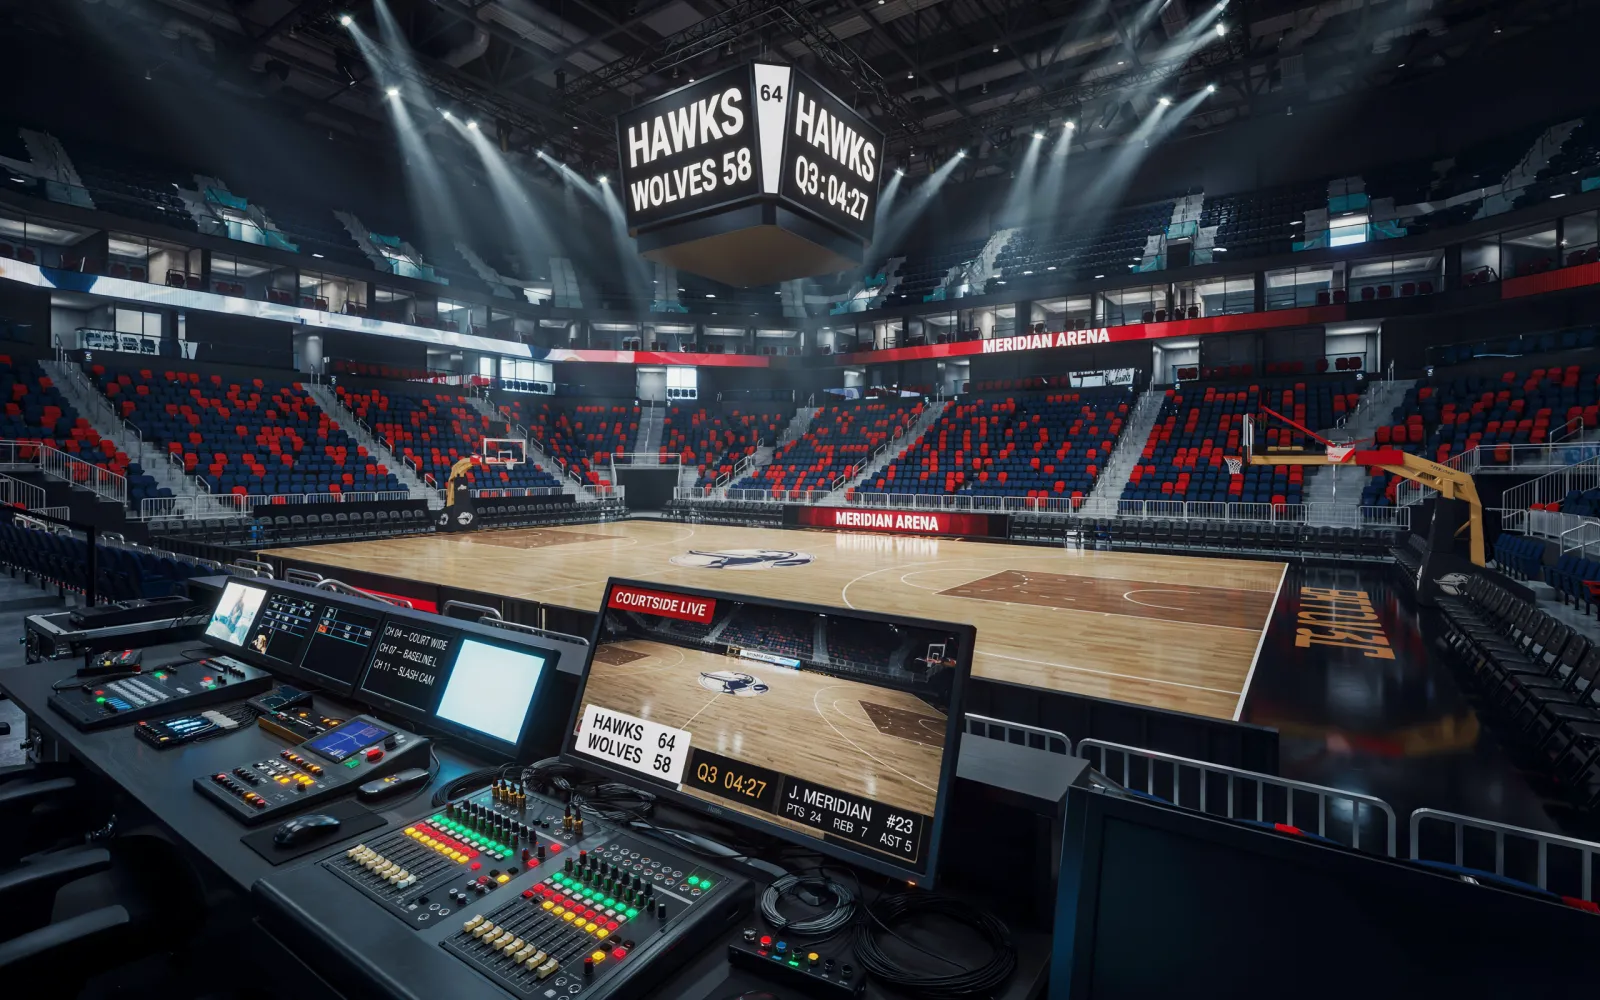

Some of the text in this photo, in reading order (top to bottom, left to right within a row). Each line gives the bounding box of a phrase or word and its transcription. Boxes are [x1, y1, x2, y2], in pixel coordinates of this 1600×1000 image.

[760, 84, 783, 102] 64
[628, 88, 744, 168] HAWKS
[795, 91, 876, 183] HAWKS
[630, 147, 752, 212] WOLVES 58
[982, 328, 1110, 354] MERIDIAN ARENA
[836, 512, 939, 531] MERIDIAN ARENA
[615, 591, 707, 617] COURTSIDE LIVE
[379, 643, 388, 653] CH
[388, 645, 397, 655] 07
[402, 649, 433, 666] BASELINE
[385, 626, 394, 637] CH
[394, 629, 402, 638] 04
[408, 632, 431, 646] COURT
[430, 638, 448, 651] WIDE
[373, 659, 383, 670] CH
[383, 662, 391, 672] 11
[397, 666, 420, 681] SLASH
[418, 673, 435, 686] CAM
[592, 713, 676, 752] HAWKS 64
[588, 732, 672, 774] WOLVES 58
[697, 762, 767, 799] Q3 04:27
[786, 802, 912, 853] PTS 24 REB 7 AST 5
[788, 785, 914, 834] J. MERIDIAN #23
